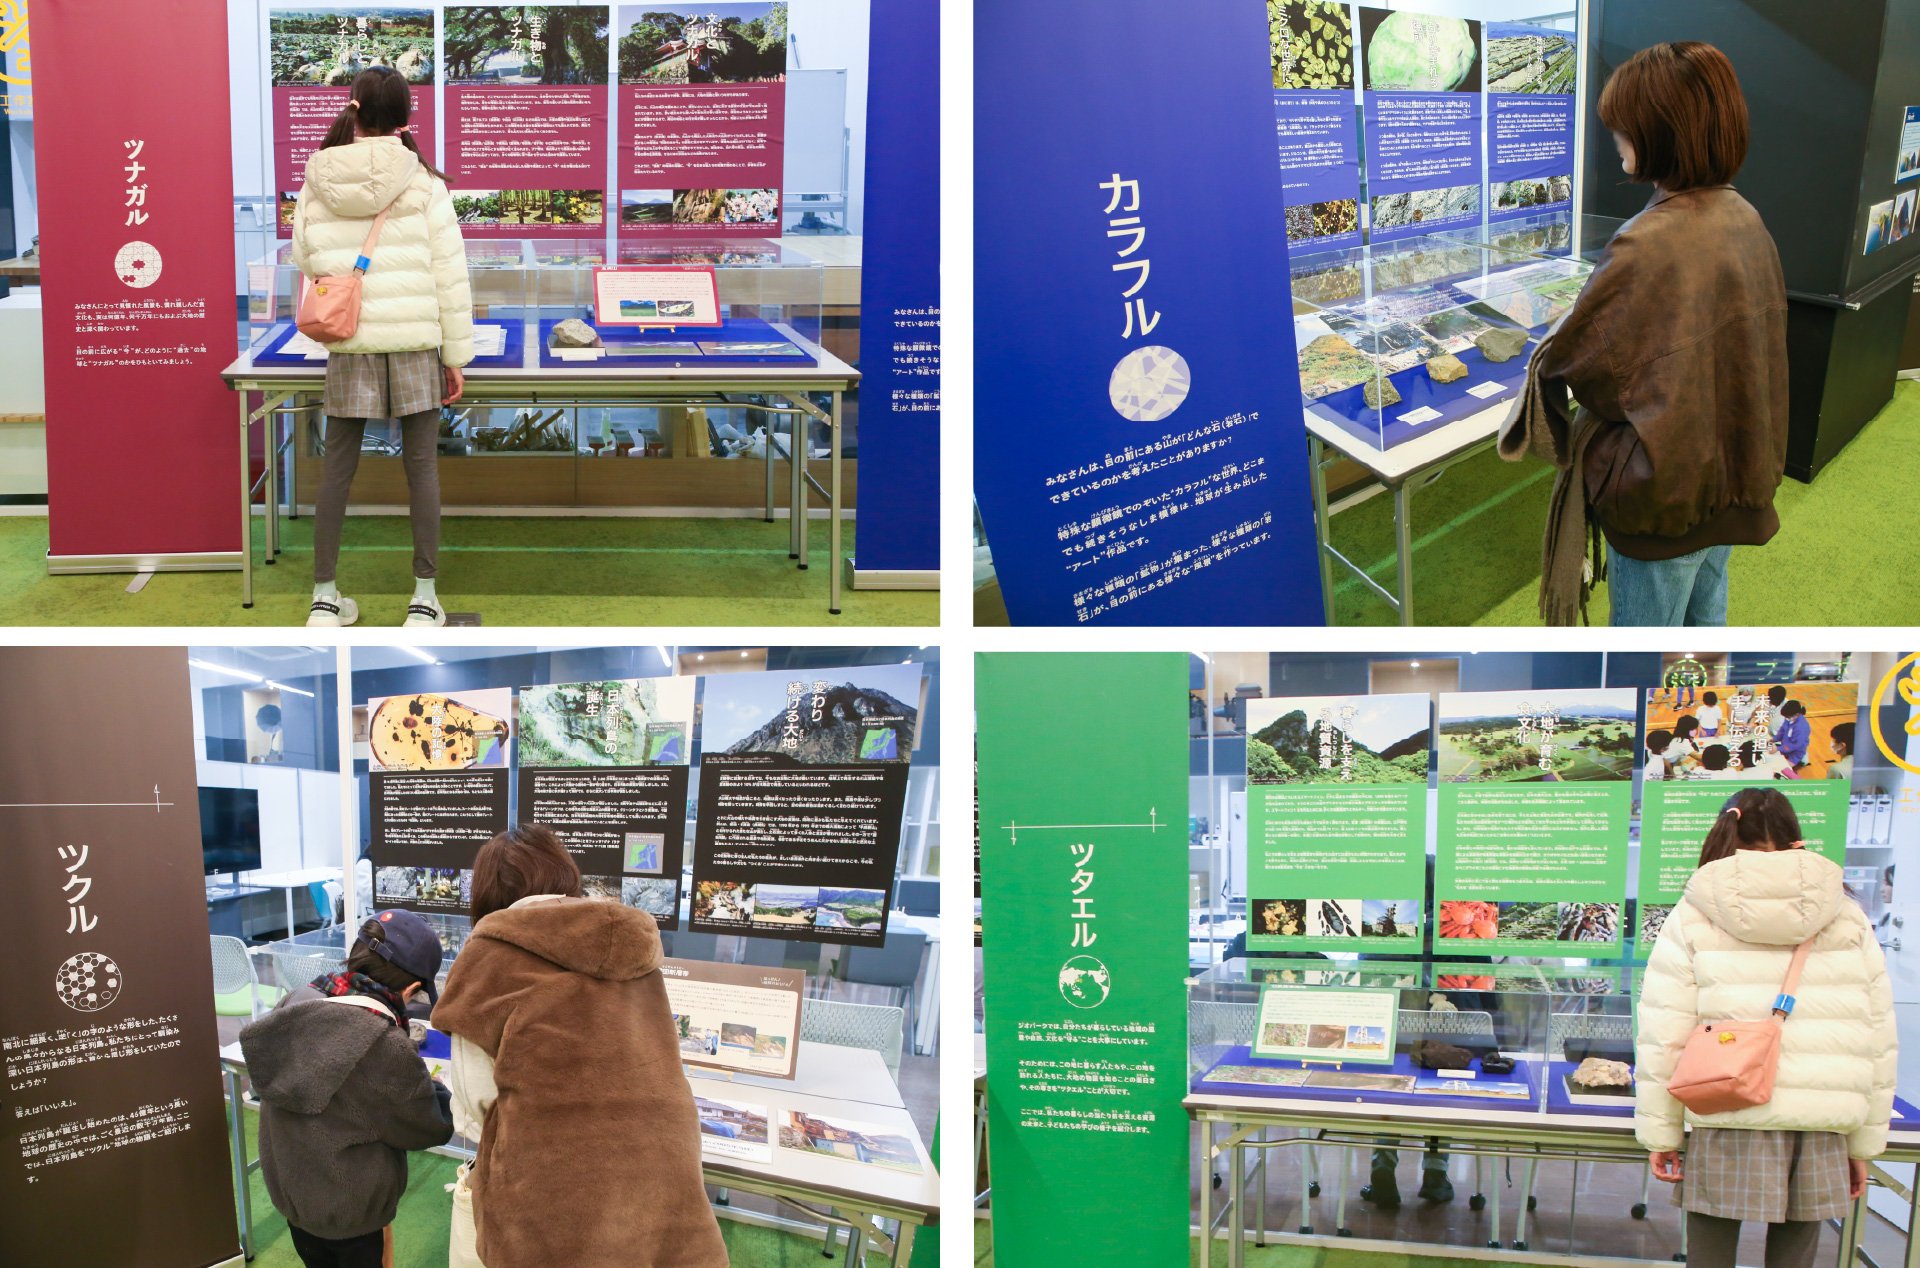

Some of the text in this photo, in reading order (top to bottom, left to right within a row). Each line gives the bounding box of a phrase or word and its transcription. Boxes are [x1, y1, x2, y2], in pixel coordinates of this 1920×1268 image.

[355, 16, 369, 64] 暮らしと
[510, 15, 524, 62] ツナガル
[530, 15, 542, 63] 生き物と
[686, 13, 698, 61] ツナガル
[705, 12, 718, 50] 文化と
[124, 139, 150, 228] ツナガル
[1098, 175, 1160, 340] カラフル
[585, 690, 600, 717] 誕生
[604, 689, 621, 755] 日本列島の
[782, 682, 803, 749] 続ける大地
[811, 680, 827, 722] 変わり
[1726, 695, 1746, 768] 手に伝える
[1752, 693, 1771, 767] 未来の担い
[1538, 700, 1554, 772] 大地が育む
[58, 844, 98, 935] ツクル
[1071, 844, 1098, 950] ツタエル
[27, 1176, 39, 1184] す。
